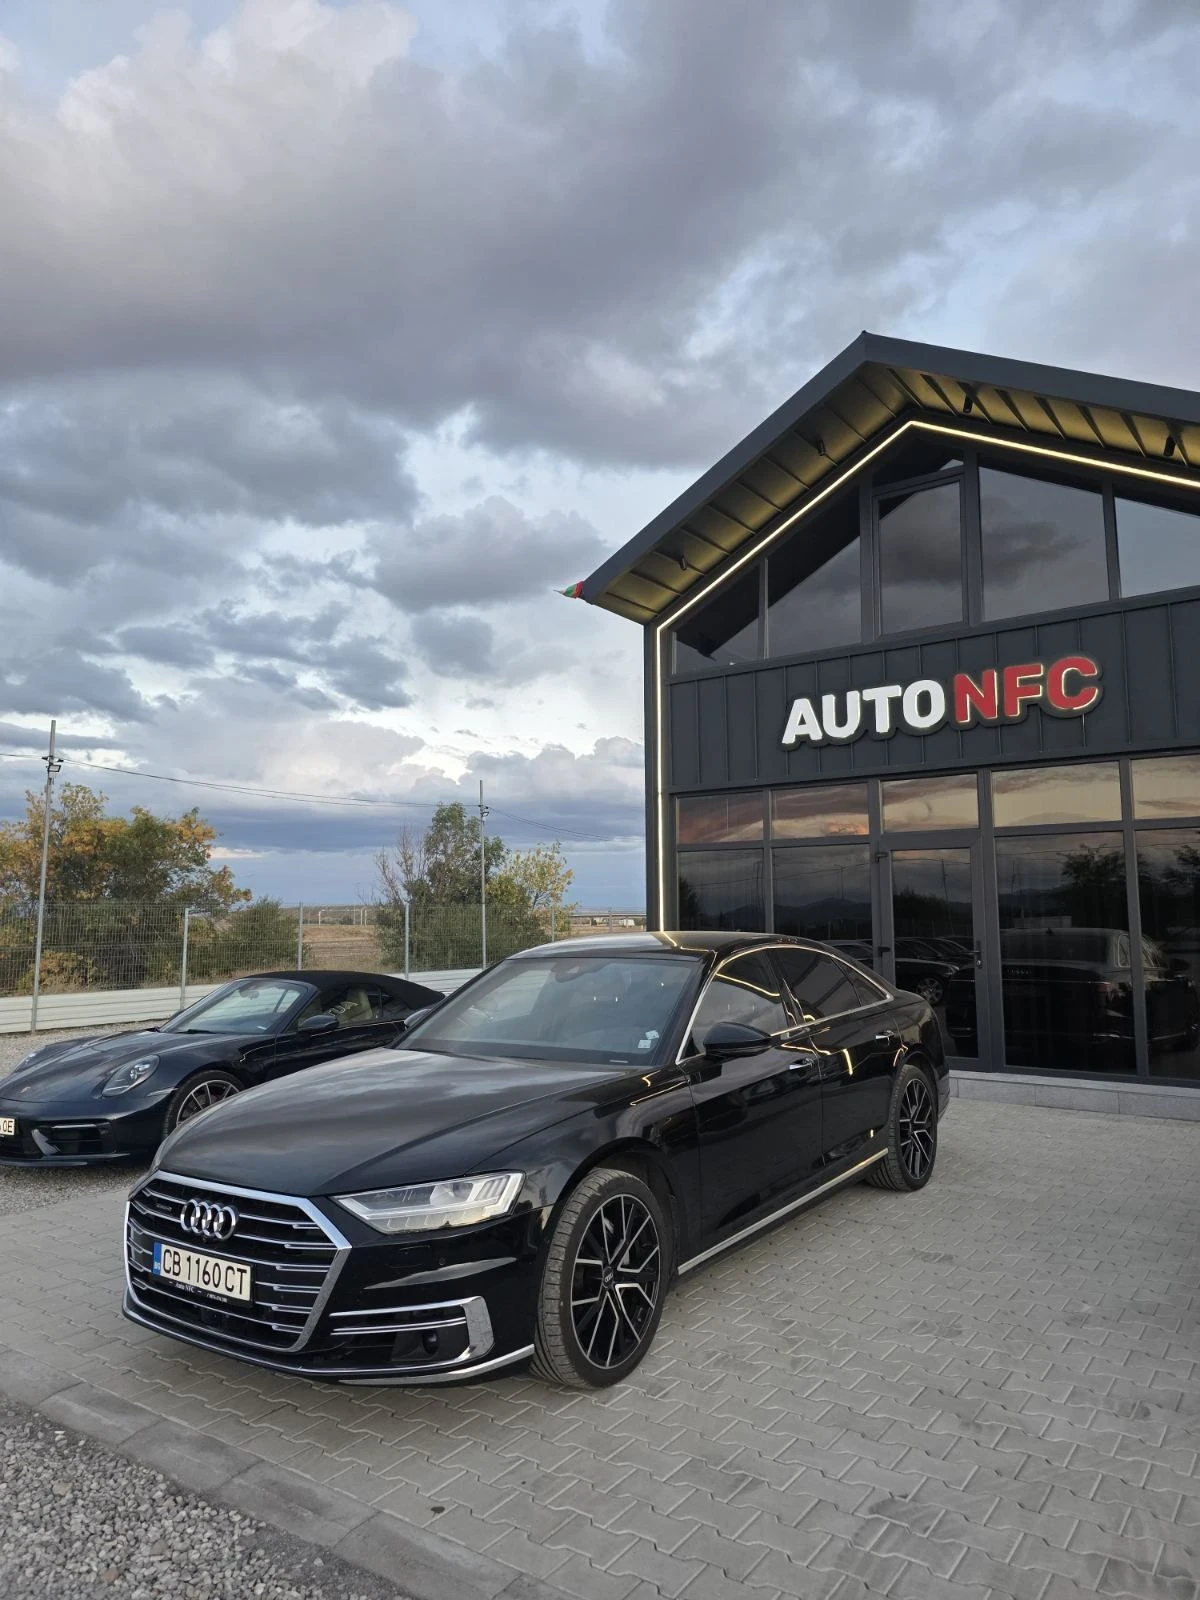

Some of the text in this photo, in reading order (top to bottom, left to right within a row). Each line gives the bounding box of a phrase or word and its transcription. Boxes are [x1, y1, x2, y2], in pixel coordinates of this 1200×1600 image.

[781, 656, 1098, 744] AUTO NFC
[163, 1249, 247, 1295] CB 1160 CT
